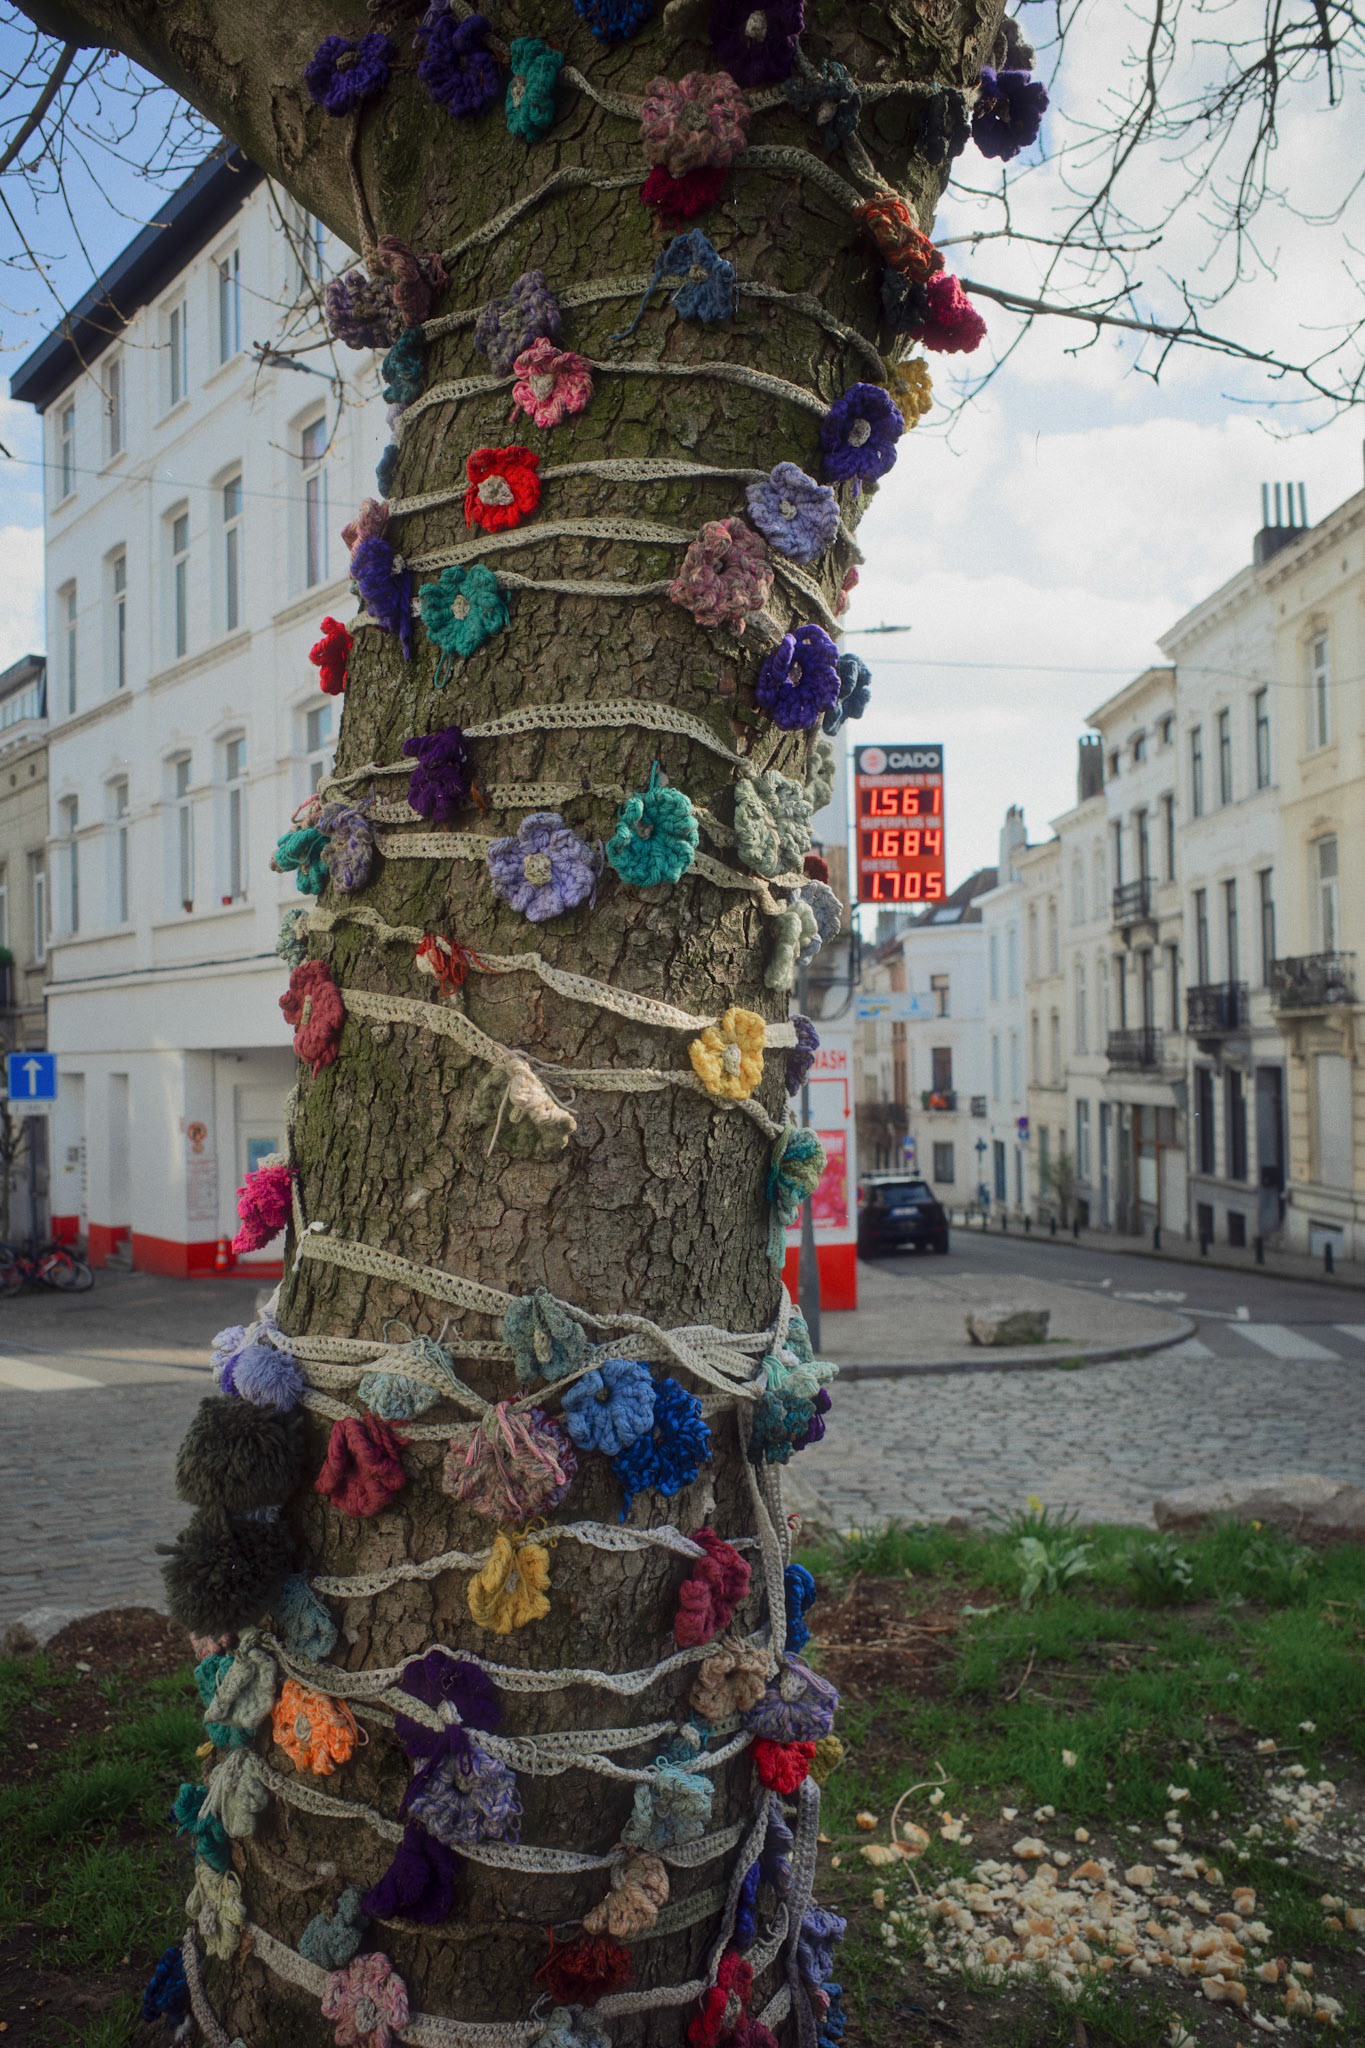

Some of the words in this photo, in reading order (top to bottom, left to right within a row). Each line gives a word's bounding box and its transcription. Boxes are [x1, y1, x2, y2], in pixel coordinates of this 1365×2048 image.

[889, 752, 939, 768] CADO
[871, 788, 940, 815] 1.561
[871, 830, 941, 857] 1.684
[861, 859, 899, 871] DIESEL
[872, 872, 942, 899] 1.705
